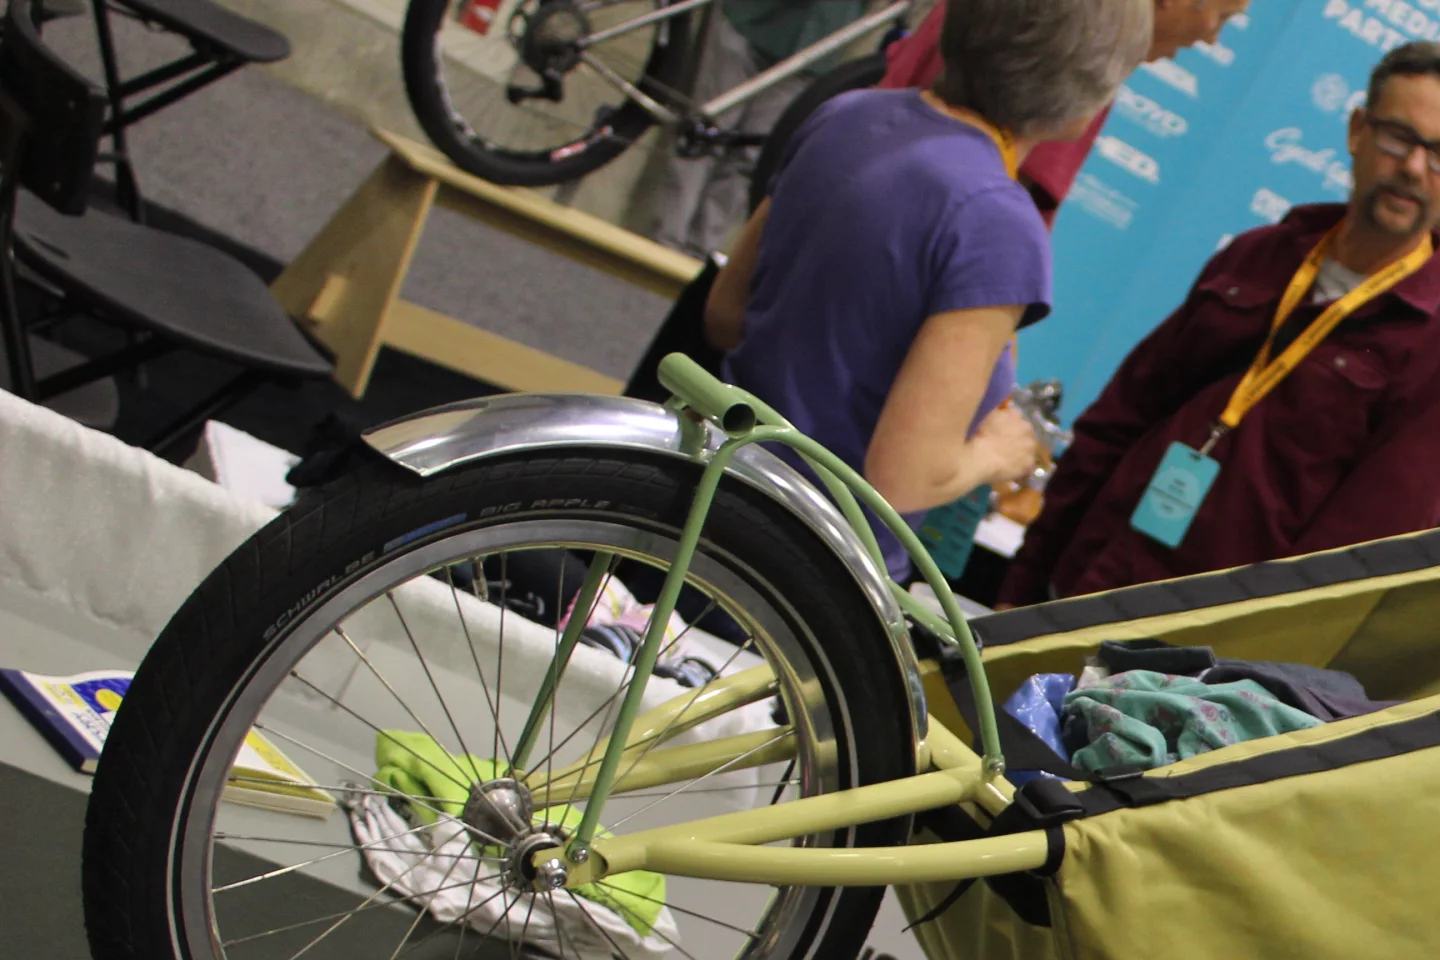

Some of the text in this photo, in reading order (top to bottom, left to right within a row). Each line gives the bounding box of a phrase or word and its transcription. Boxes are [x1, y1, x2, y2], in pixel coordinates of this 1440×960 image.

[1322, 0, 1407, 50] PART
[530, 498, 611, 510] APPLE
[262, 550, 376, 642] SCHWALBE
